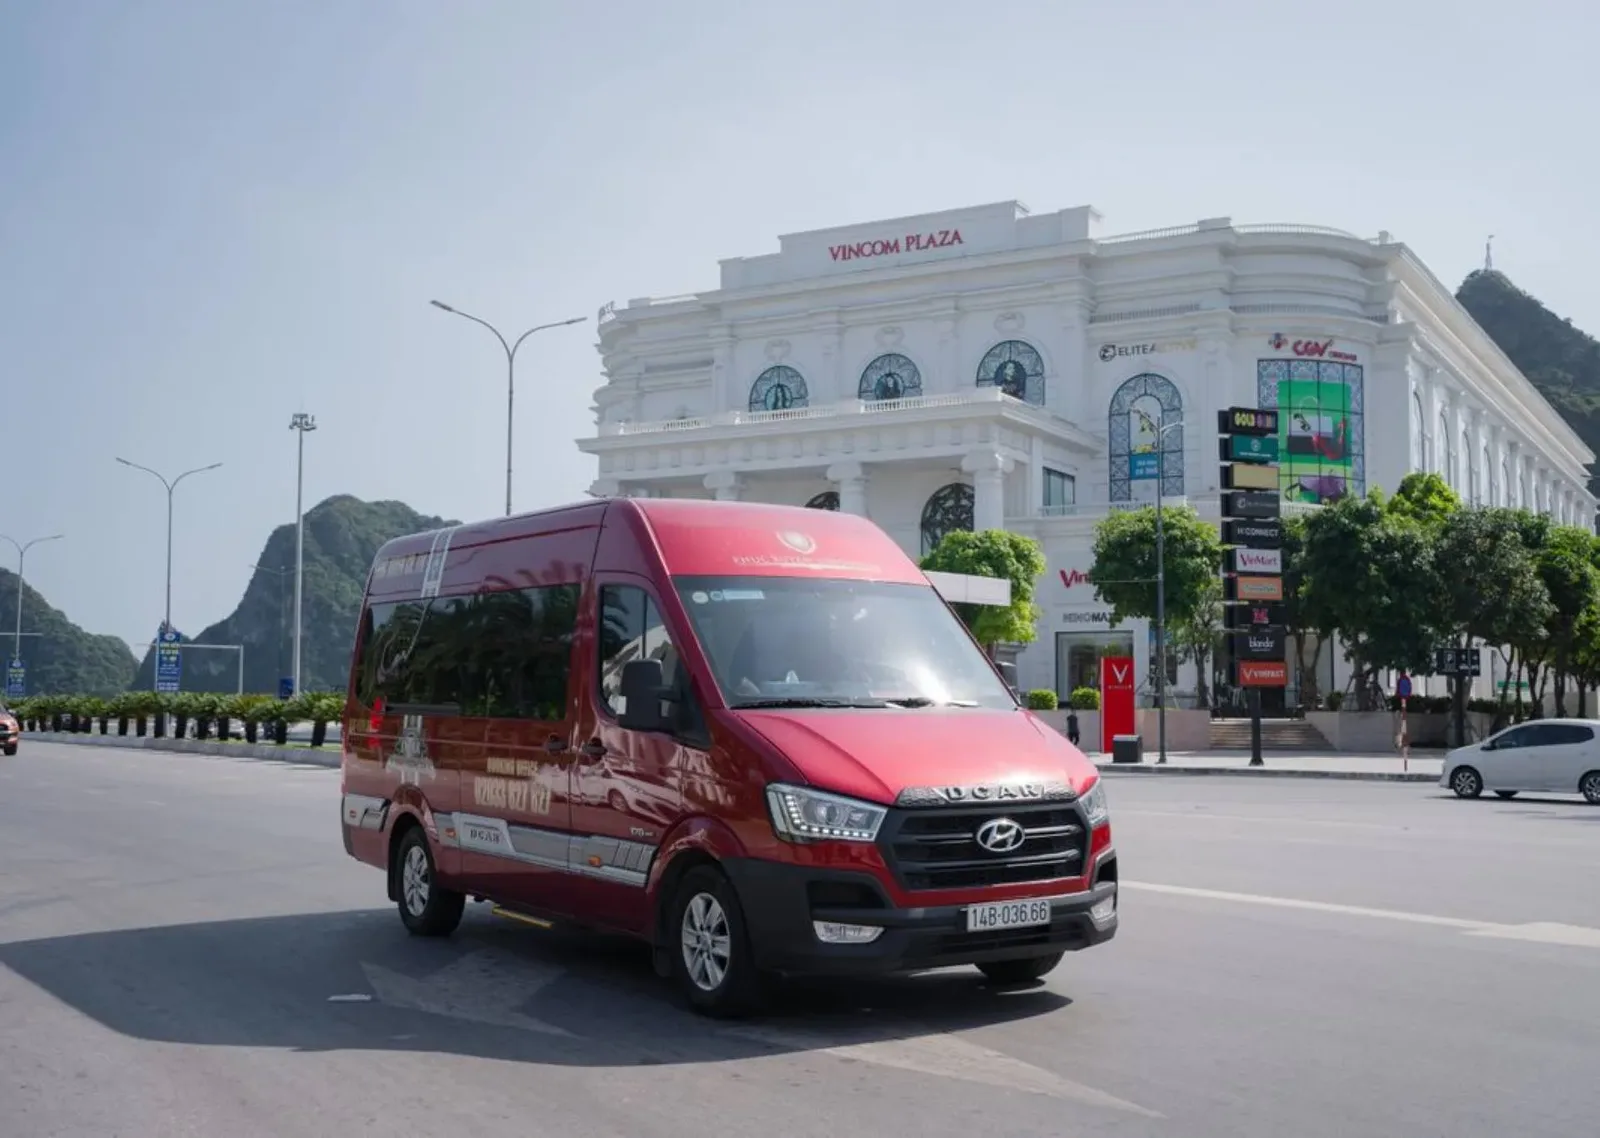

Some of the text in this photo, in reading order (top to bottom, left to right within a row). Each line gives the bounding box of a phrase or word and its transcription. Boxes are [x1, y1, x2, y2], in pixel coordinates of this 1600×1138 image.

[828, 229, 963, 261] VINCOM PLAZA
[1059, 568, 1092, 589] Vin
[946, 782, 1039, 800] DCAR
[971, 901, 1047, 928] 14B-036.66
